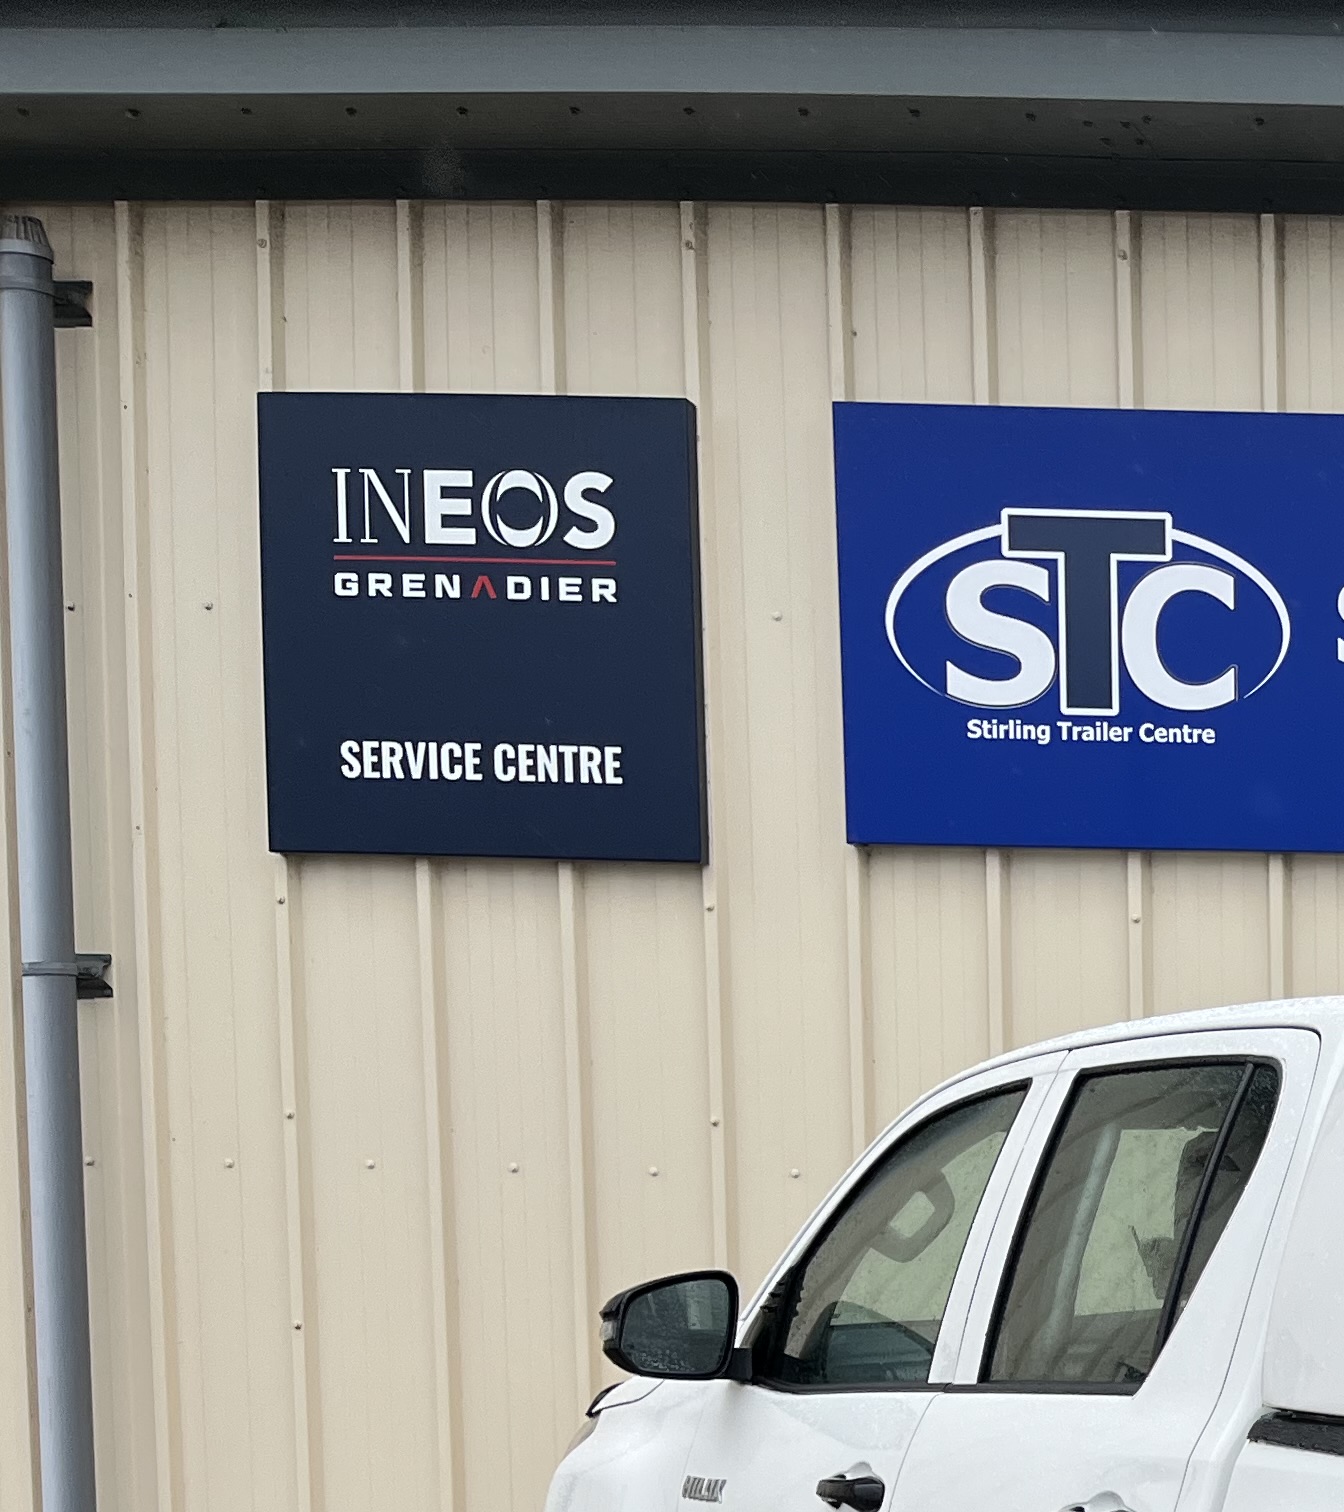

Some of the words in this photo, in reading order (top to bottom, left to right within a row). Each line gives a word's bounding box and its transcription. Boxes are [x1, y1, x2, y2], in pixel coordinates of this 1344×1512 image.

[332, 467, 617, 549] INEOS
[334, 572, 618, 603] GRENADIER
[945, 507, 1237, 716] STC
[966, 719, 1051, 745] Stirling
[1056, 721, 1133, 743] Trailer
[1139, 722, 1216, 744] Centre
[340, 740, 483, 781] SERVICE
[494, 743, 624, 785] CENTRE
